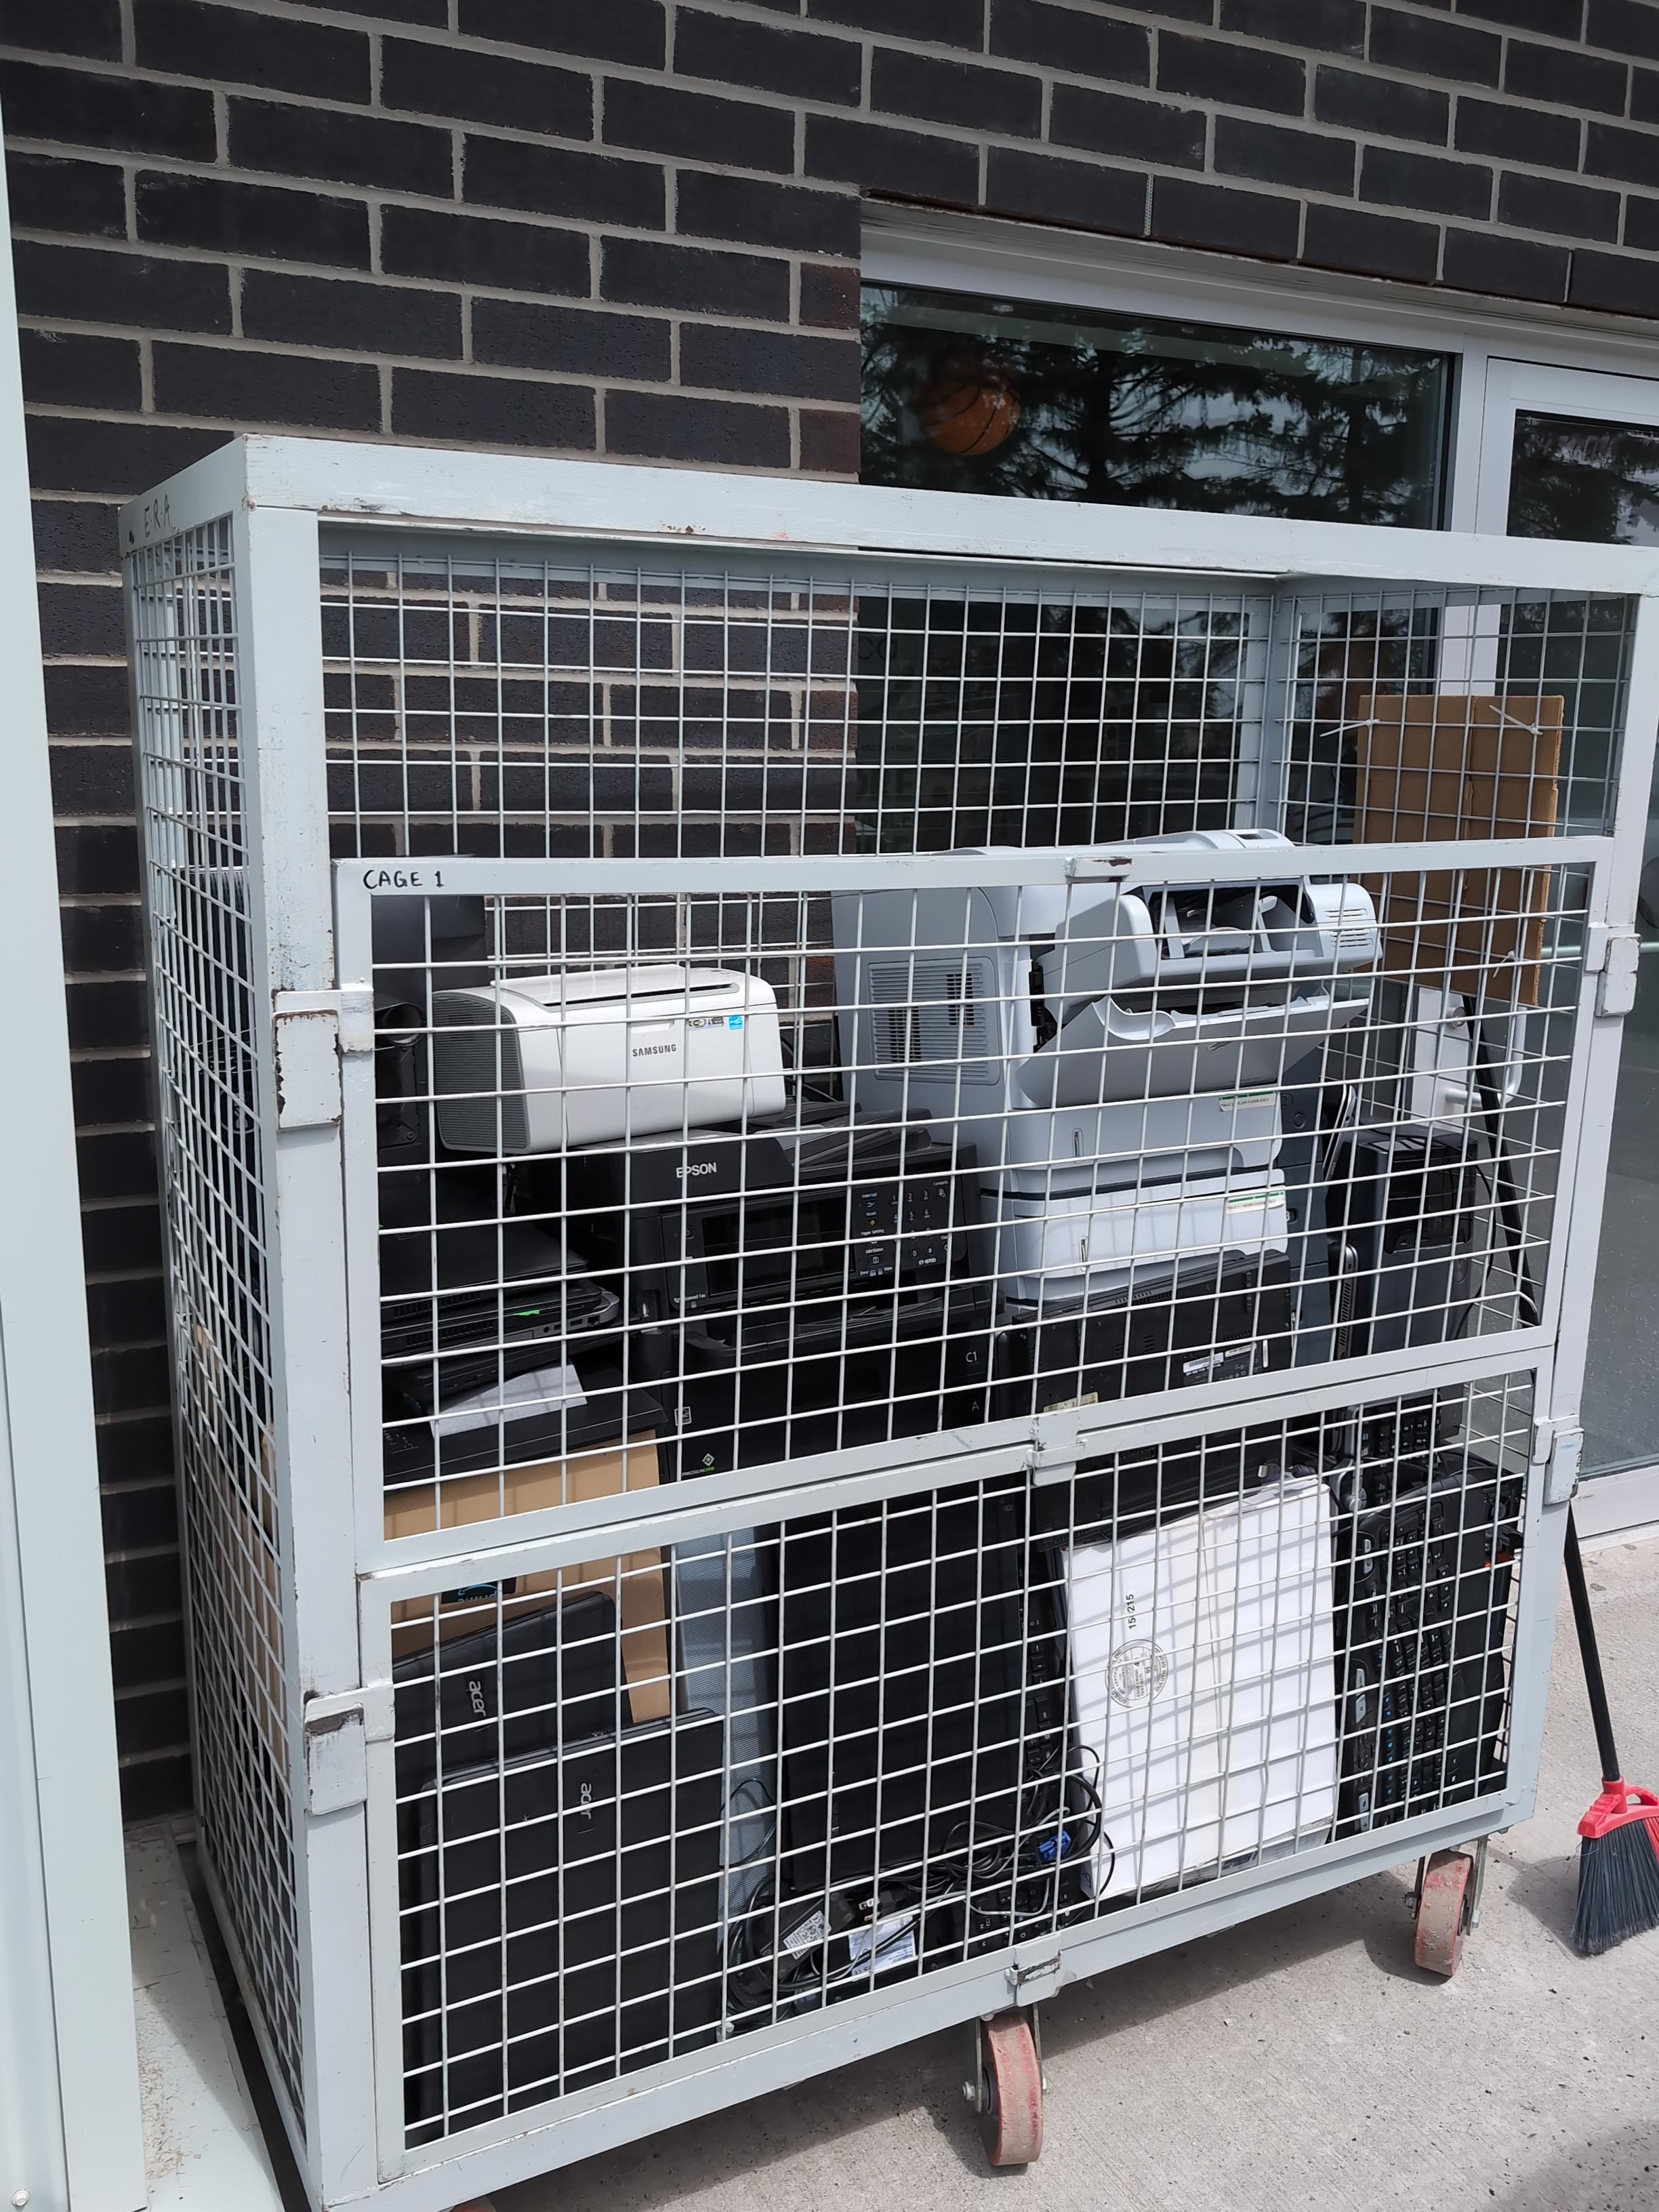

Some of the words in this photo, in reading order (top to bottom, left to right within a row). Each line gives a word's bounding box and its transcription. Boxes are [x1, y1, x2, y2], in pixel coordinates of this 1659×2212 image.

[363, 869, 423, 889] CAGE
[434, 870, 445, 888] 1
[632, 1044, 676, 1057] SAMSUNG
[676, 1162, 717, 1178] EPSON
[966, 1351, 977, 1362] C1
[971, 1400, 980, 1412] A
[1125, 1593, 1137, 1631] 15215
[469, 1681, 487, 1717] acer
